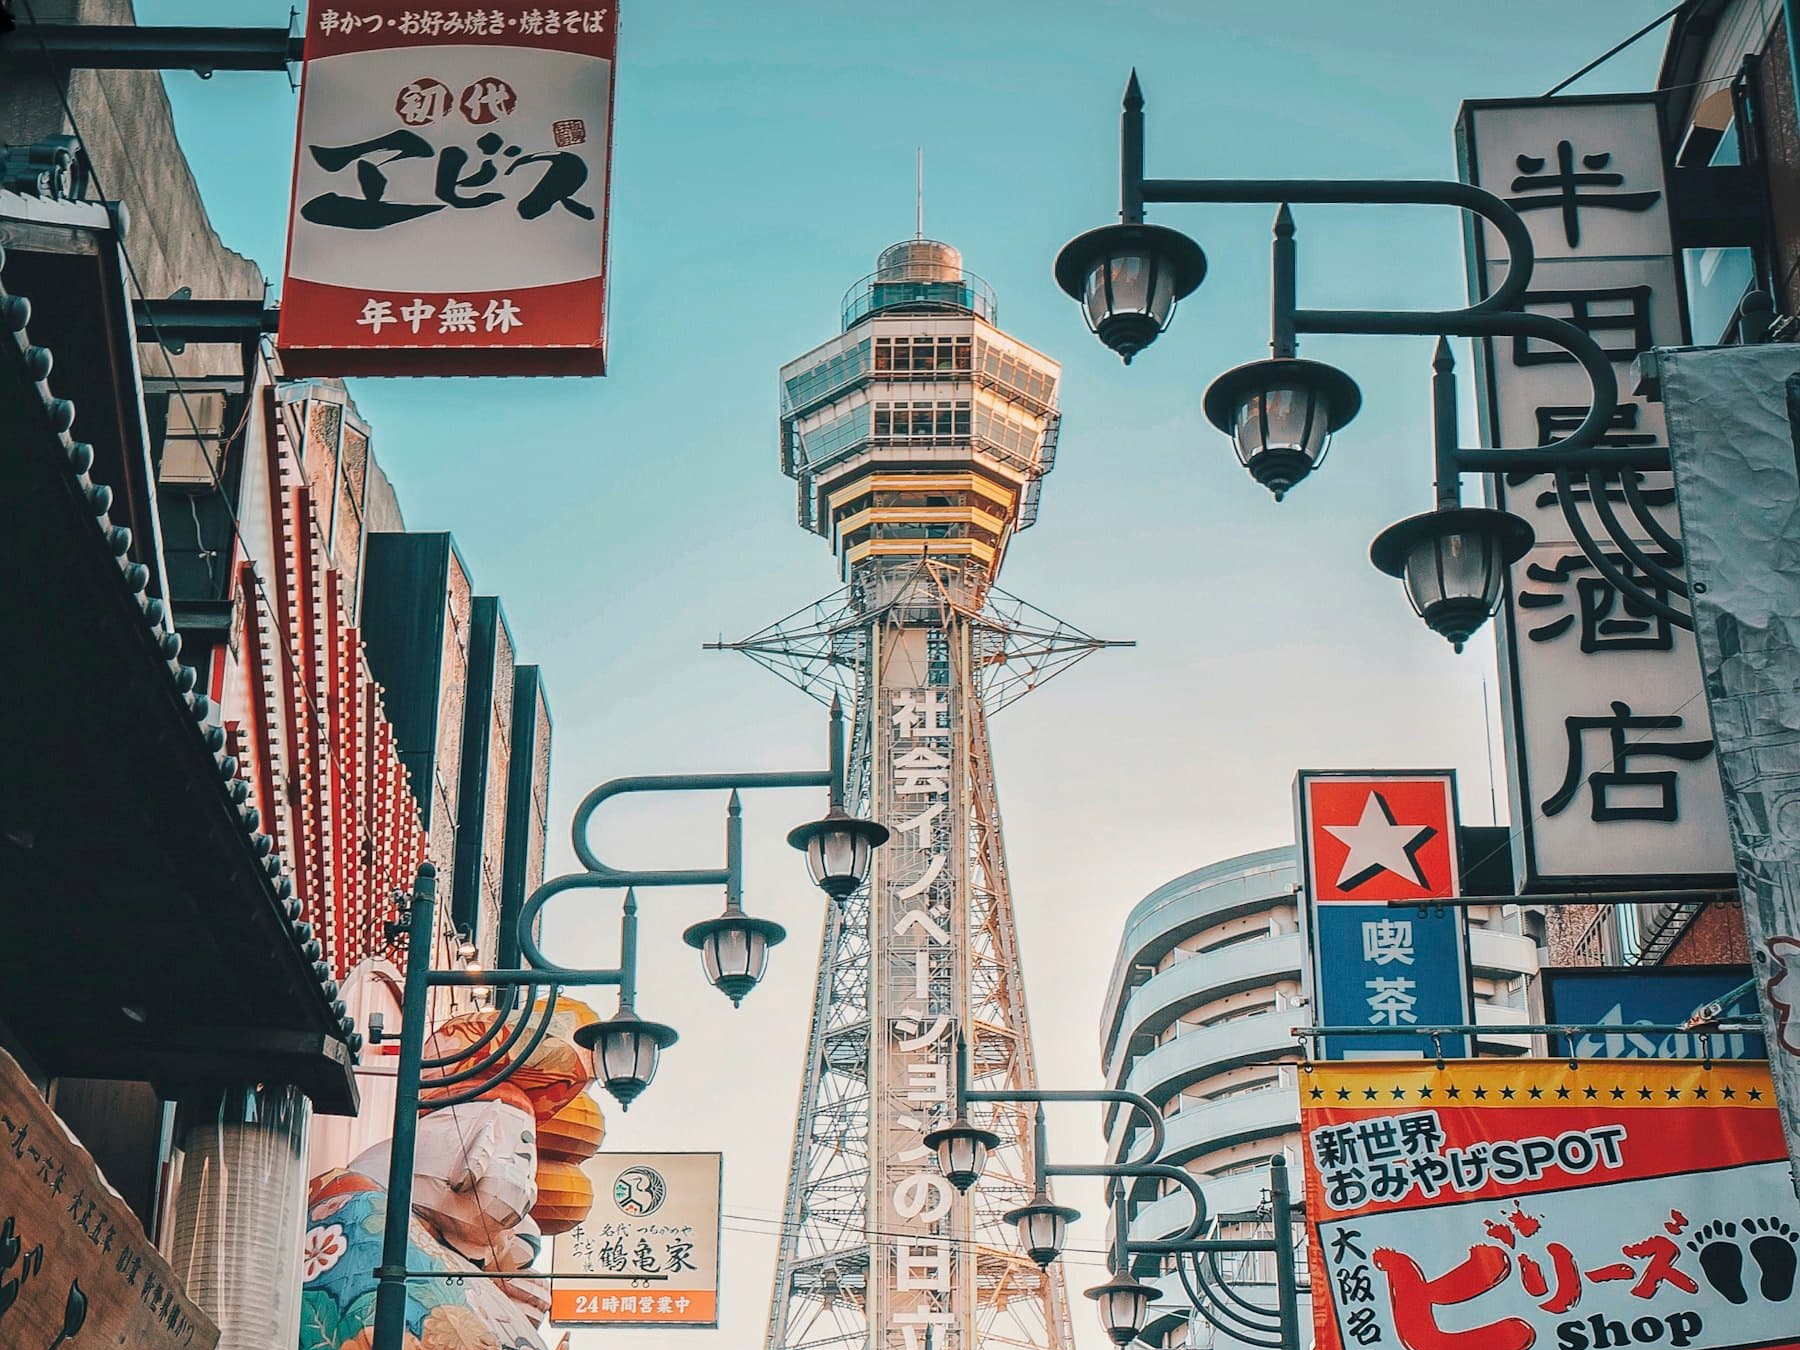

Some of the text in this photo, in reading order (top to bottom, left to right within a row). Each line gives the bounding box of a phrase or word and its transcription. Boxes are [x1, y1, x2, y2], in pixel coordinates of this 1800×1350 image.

[319, 8, 605, 36] 串かつ・お好み焼き・焼きそば
[395, 77, 518, 126] 初代
[301, 130, 595, 230] エビス
[356, 299, 523, 334] 年中無休
[1362, 920, 1418, 1025] 喫茶
[1316, 1112, 1442, 1170] 新世界
[1328, 1128, 1626, 1207] おみやげSPOT
[575, 1295, 692, 1314] 24時間営業中
